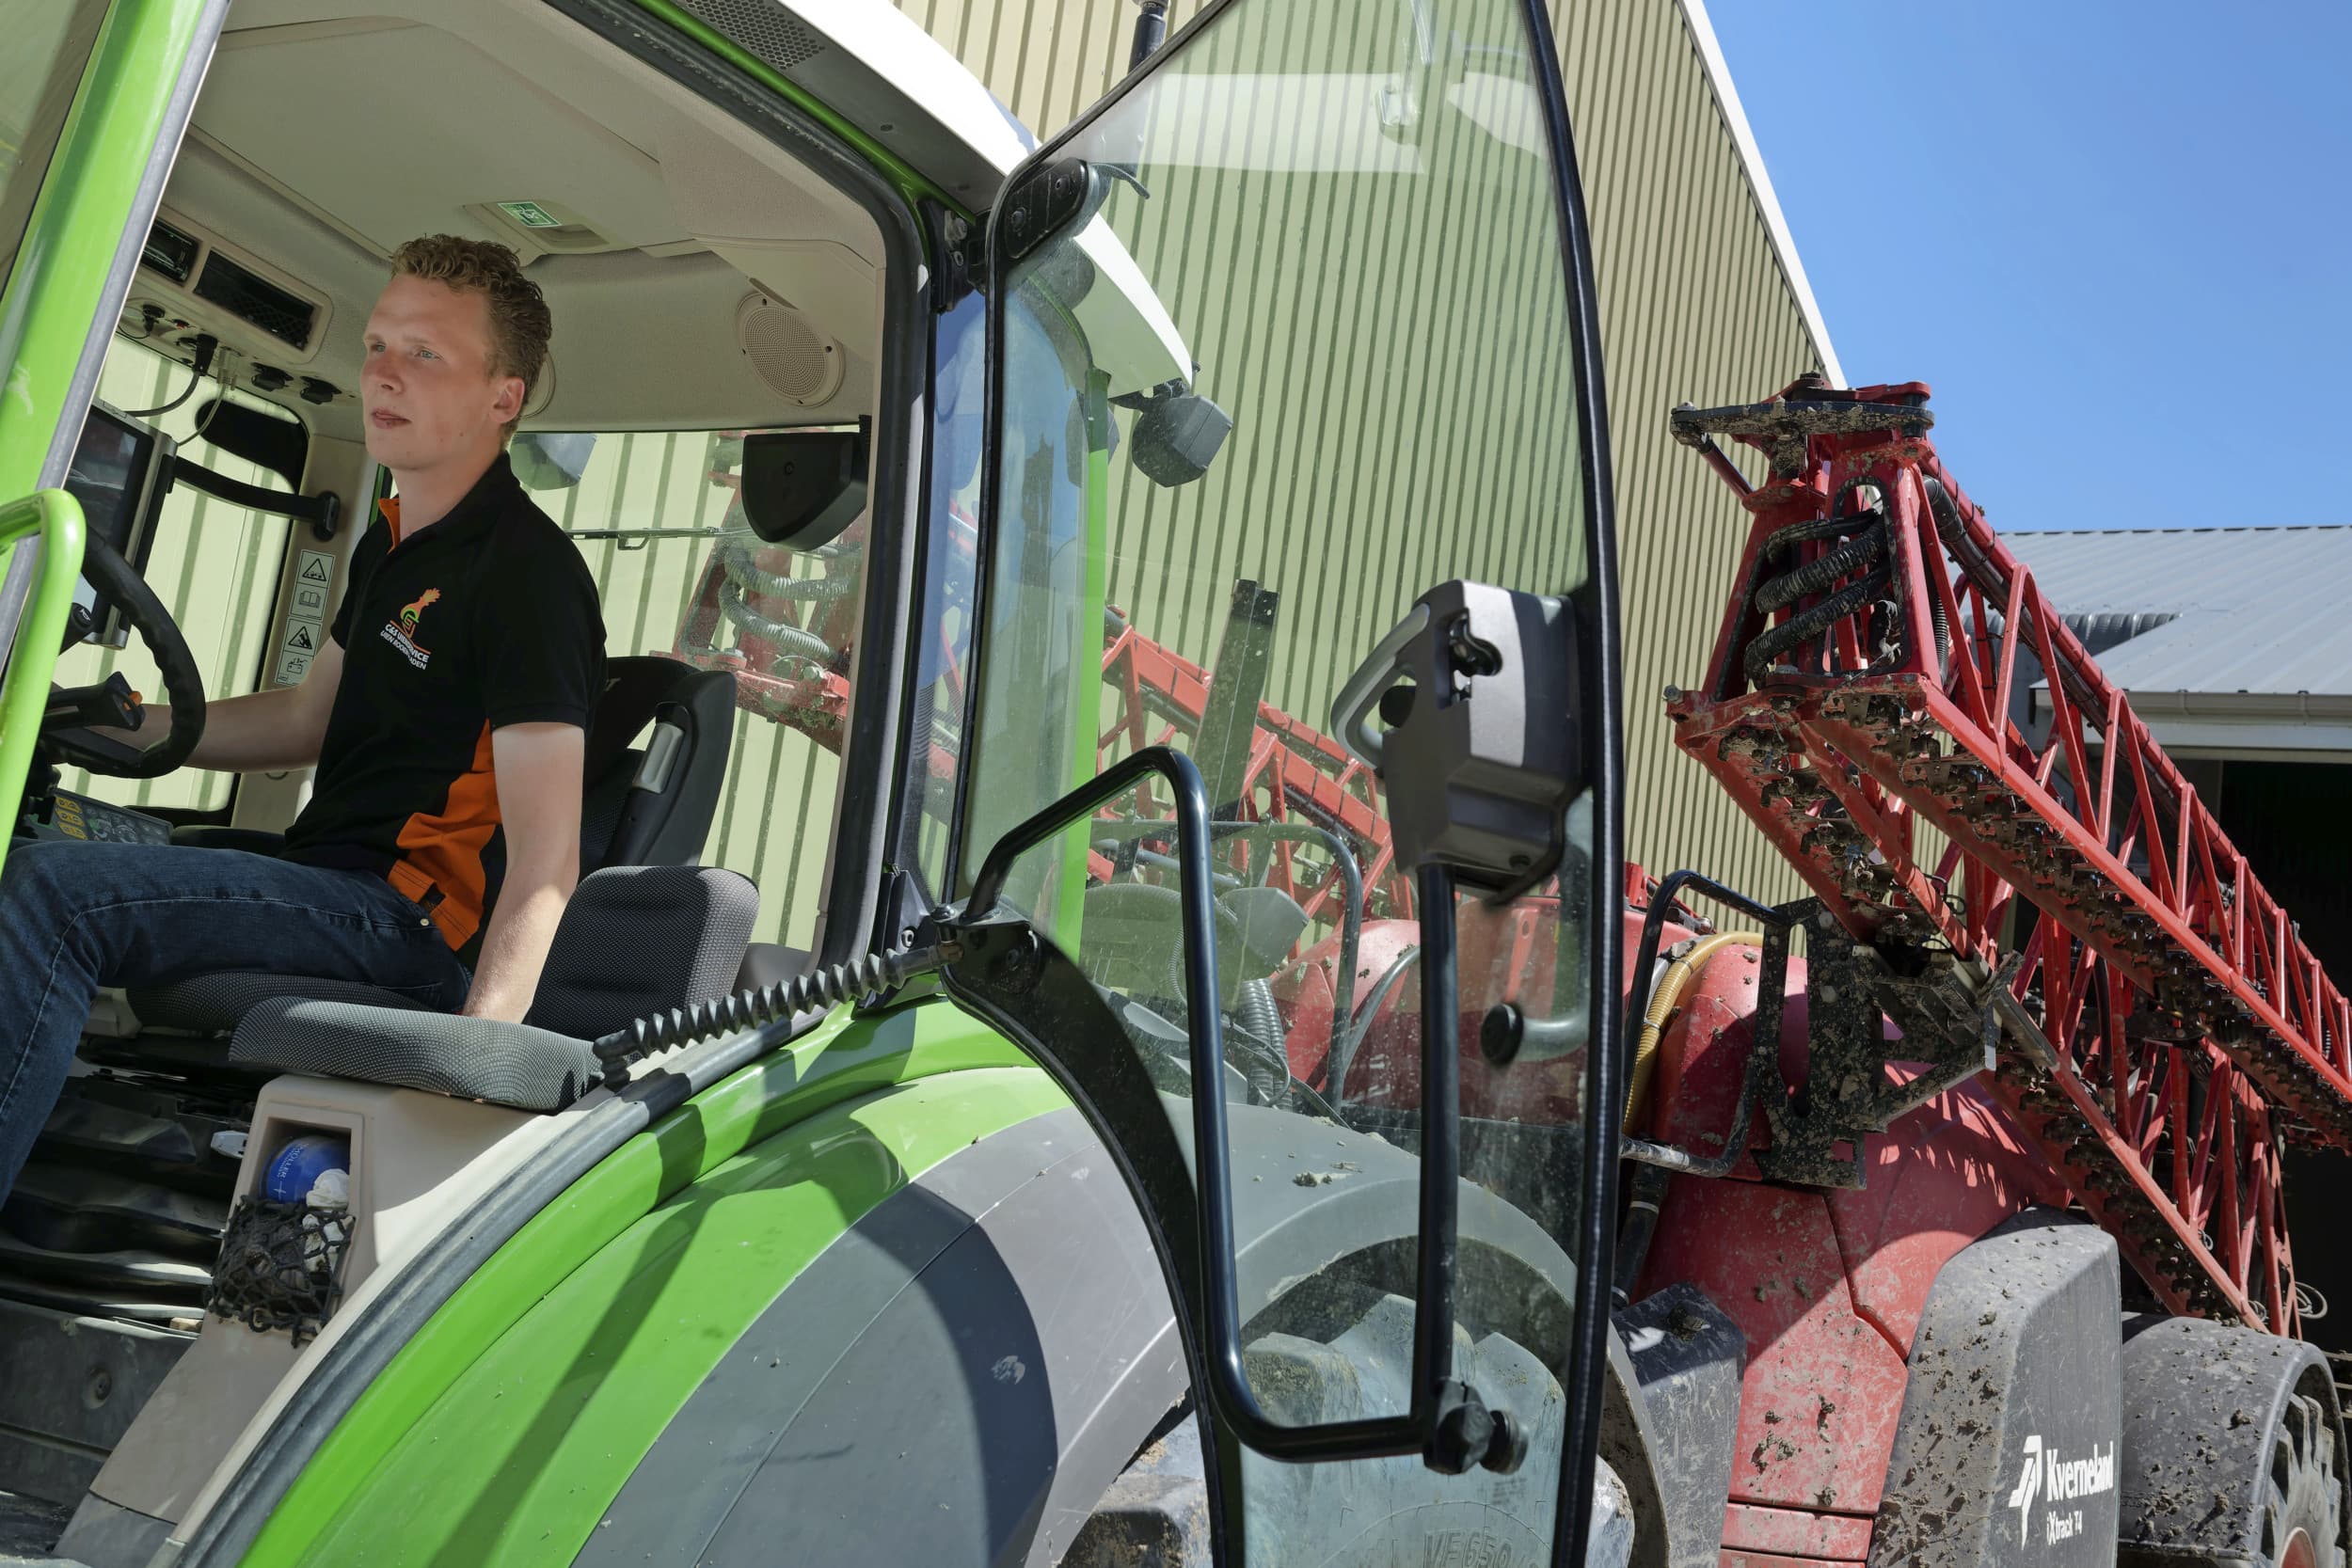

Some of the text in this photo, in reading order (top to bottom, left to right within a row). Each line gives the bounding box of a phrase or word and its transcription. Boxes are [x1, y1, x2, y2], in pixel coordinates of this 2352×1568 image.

[2046, 1440, 2114, 1502] Kverneland
[2046, 1509, 2083, 1545] iXtrack T4
